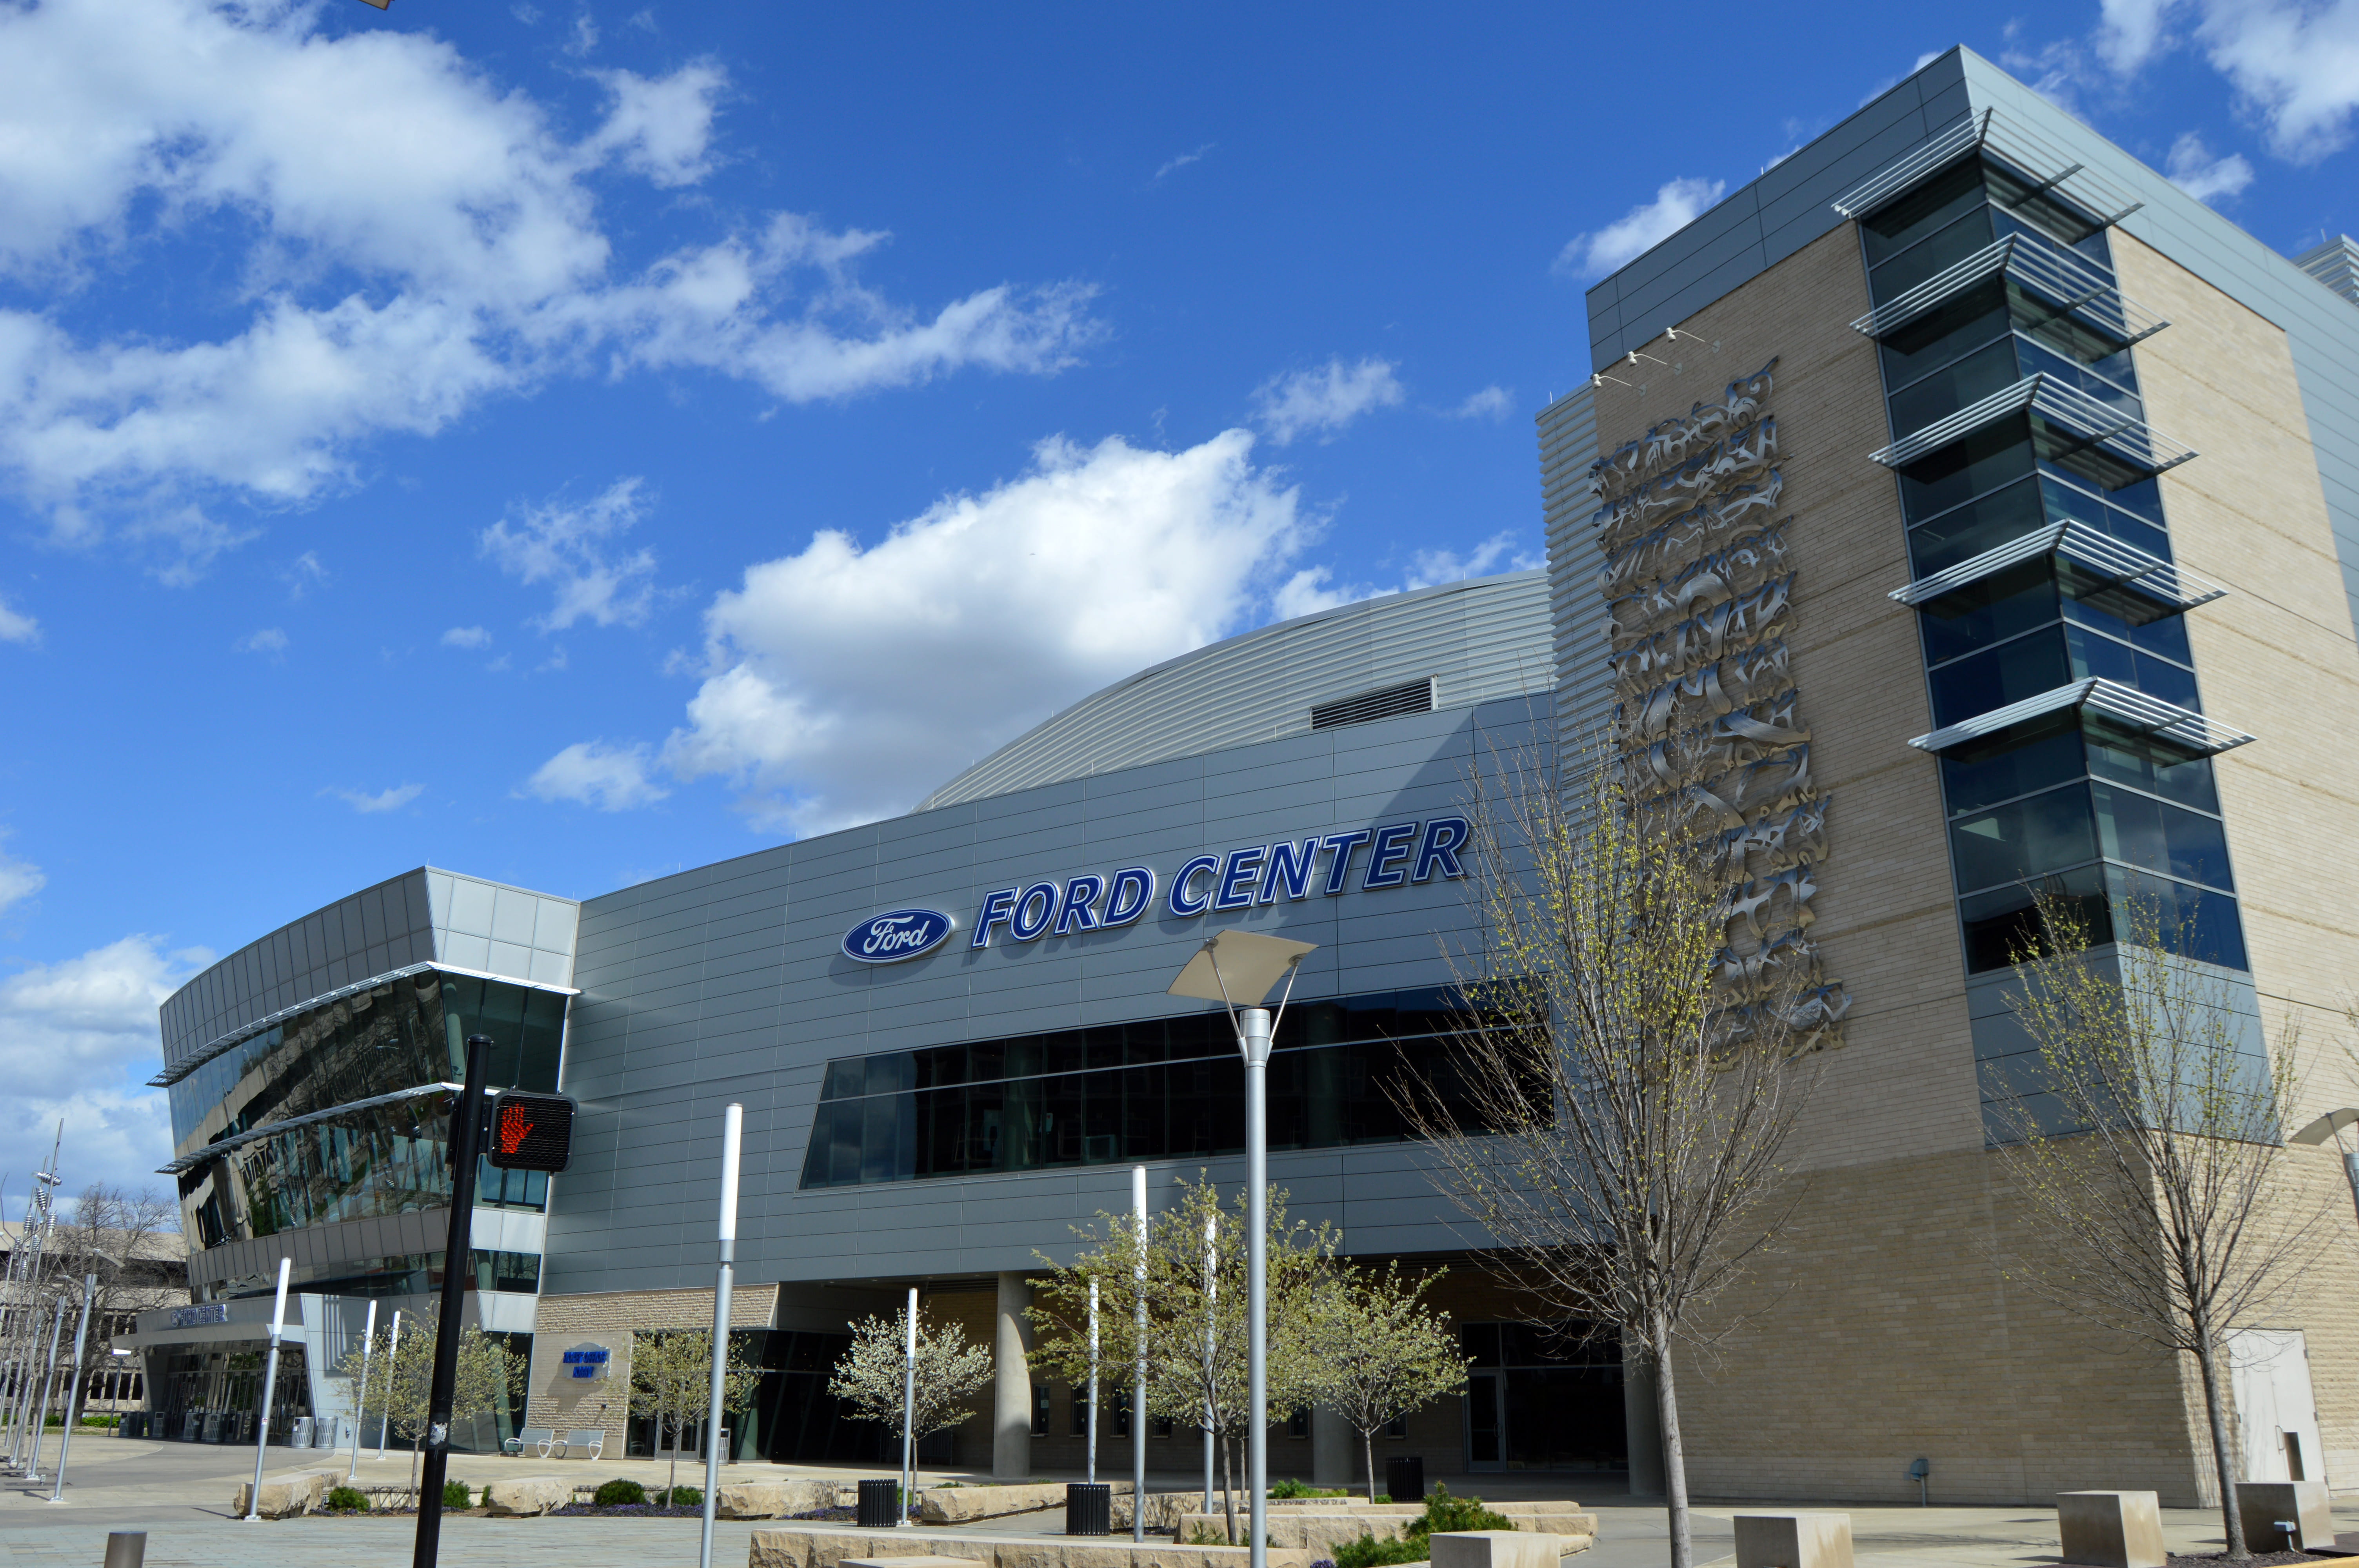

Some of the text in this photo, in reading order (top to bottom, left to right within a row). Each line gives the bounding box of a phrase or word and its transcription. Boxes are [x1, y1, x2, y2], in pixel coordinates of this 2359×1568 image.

[972, 815, 1470, 949] FORD CENTER
[863, 915, 930, 953] Ford
[181, 1308, 197, 1326] FORD
[198, 1304, 227, 1324] CENTER
[583, 1351, 607, 1363] OFFICE
